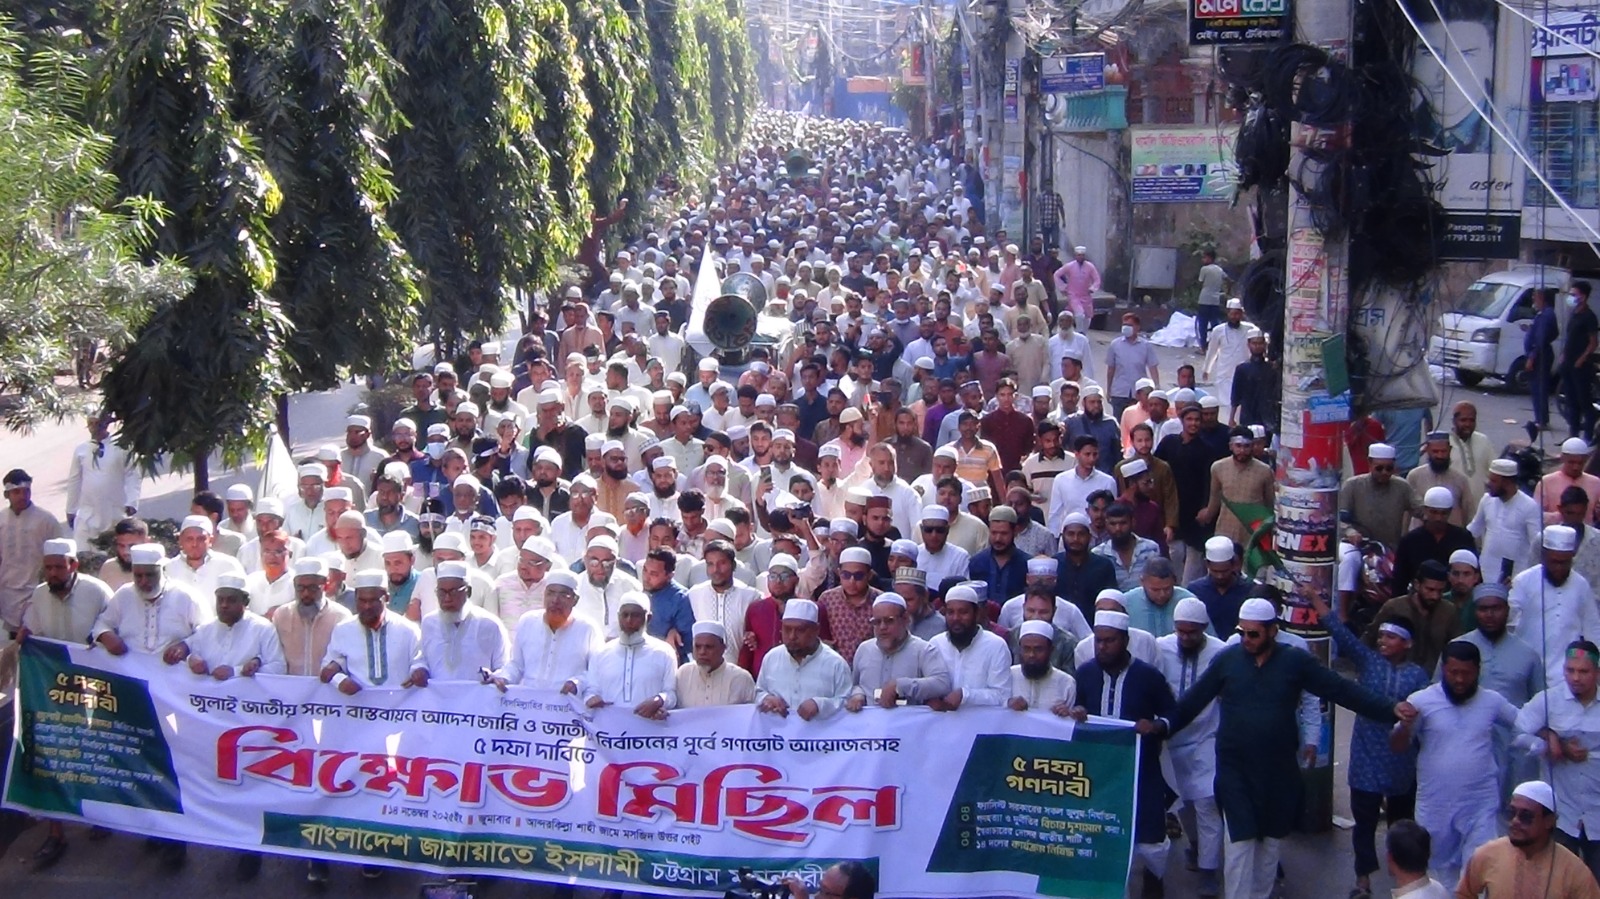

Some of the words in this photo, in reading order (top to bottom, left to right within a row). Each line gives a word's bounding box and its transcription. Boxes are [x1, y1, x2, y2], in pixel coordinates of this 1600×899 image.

[1447, 223, 1484, 232] Paragon
[49, 688, 118, 713] গণদাবী
[190, 694, 238, 713] জুলাই
[242, 699, 298, 719] জাতীয়
[301, 703, 342, 718] সনদ
[346, 705, 418, 723] বাস্তবায়ন
[422, 710, 476, 727] আদেশ
[477, 712, 520, 732] জারি
[524, 719, 537, 732] ও
[596, 731, 679, 751] নির্বাচনের
[683, 732, 716, 756] পূর্বে
[721, 734, 785, 752] গণভোট
[788, 738, 901, 754] আয়োজনসহ
[474, 738, 486, 755] ৫
[491, 738, 531, 758] দফা
[535, 739, 597, 765] দাবিতে
[1013, 757, 1027, 772] ৫
[1033, 758, 1083, 777] দফা
[216, 724, 570, 807] বিক্ষোভ
[597, 760, 901, 844] মিছিল
[1005, 775, 1090, 798] গণদাবী
[388, 806, 398, 816] ১৪
[401, 806, 429, 819] নভেম্বর
[526, 817, 573, 833] আন্দরকিল্লা
[576, 821, 596, 834] শাহী
[599, 826, 621, 837] জামে
[657, 830, 679, 843] উত্তর
[1041, 816, 1066, 829] বিচার
[300, 823, 412, 856] বাংলাদেশ
[419, 837, 538, 865] জামায়াতে
[545, 841, 645, 879] ইসলামী
[651, 856, 721, 886] চট্টগ্রাম
